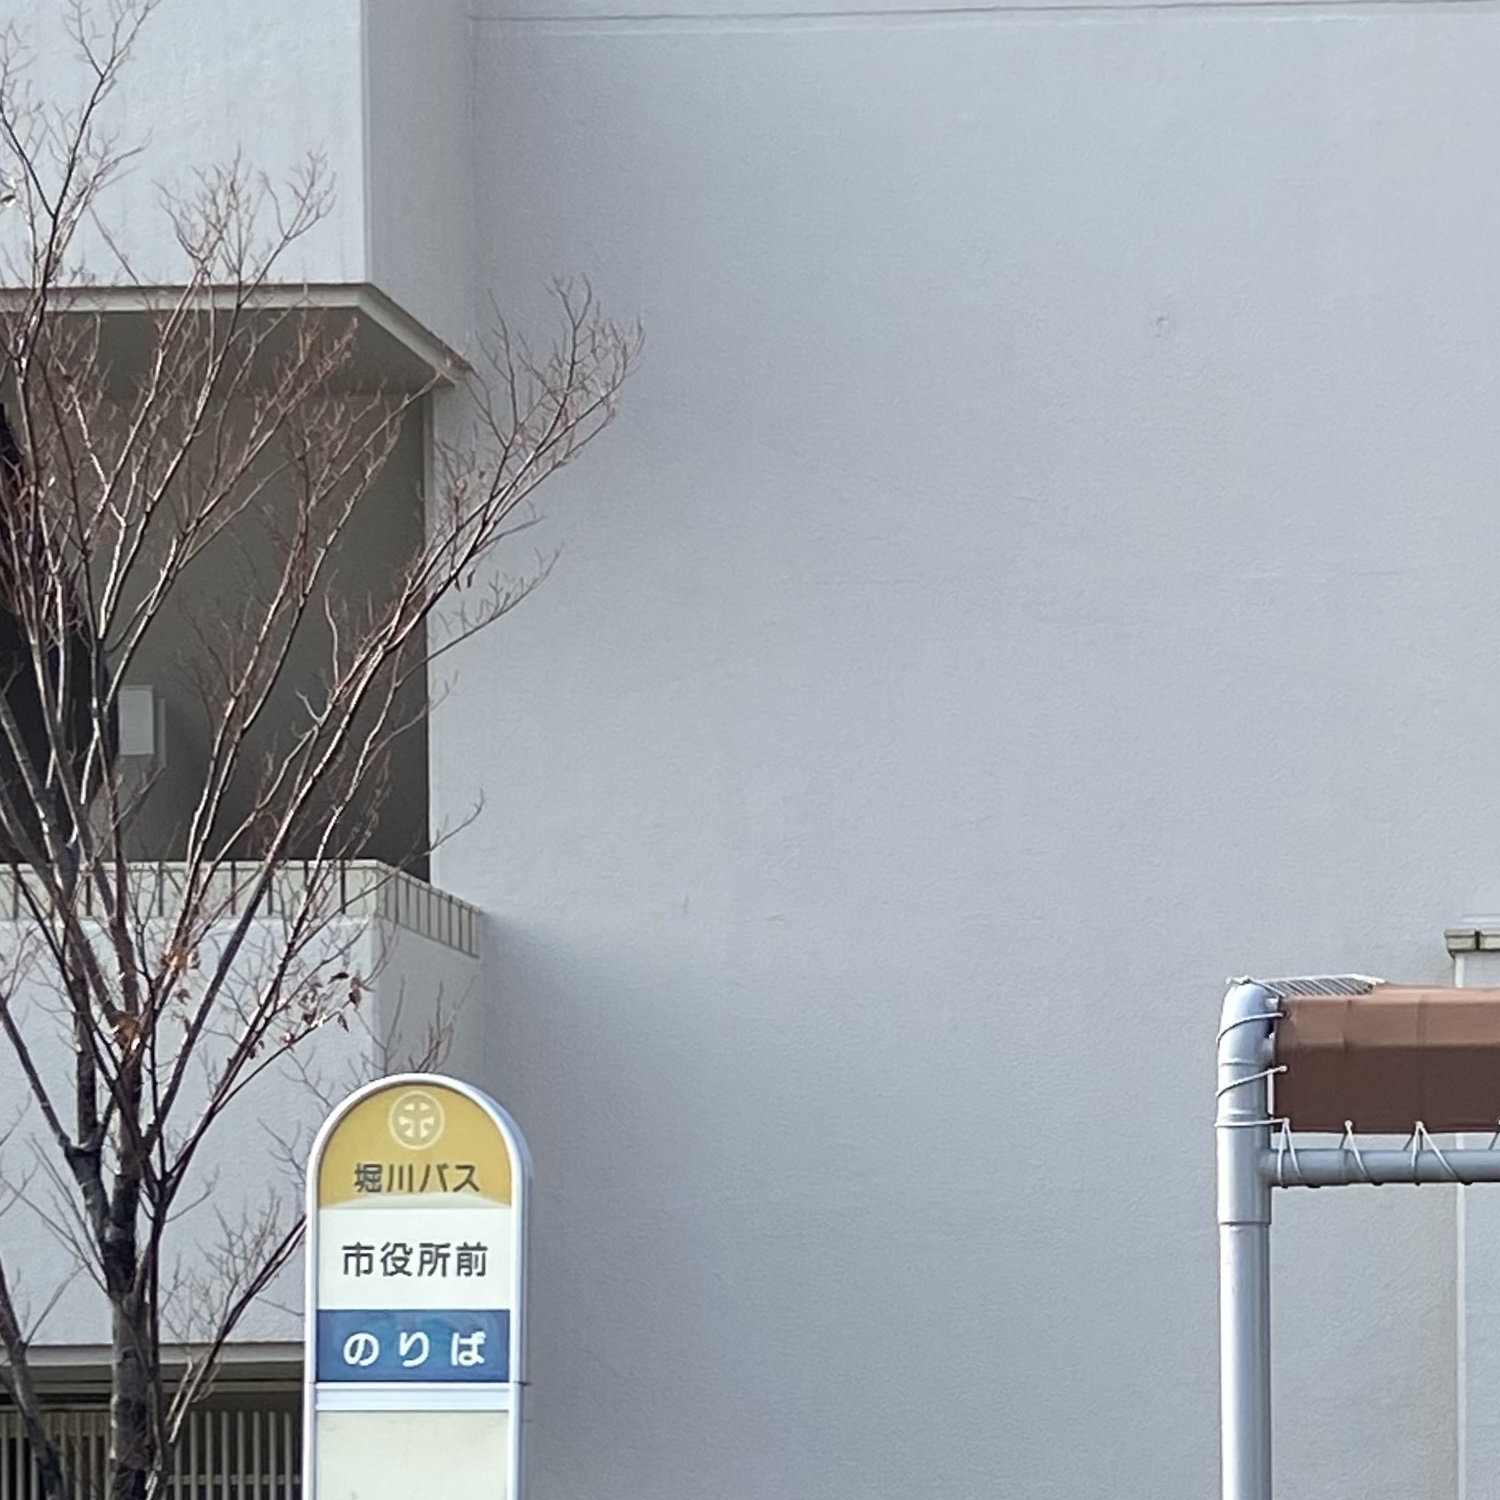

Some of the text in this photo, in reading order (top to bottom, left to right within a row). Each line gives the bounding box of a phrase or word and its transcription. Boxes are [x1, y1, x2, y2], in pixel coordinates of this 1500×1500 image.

[354, 1163, 480, 1193] 堀川バス
[342, 1242, 488, 1277] 市役所前
[343, 1331, 487, 1367] のりば
